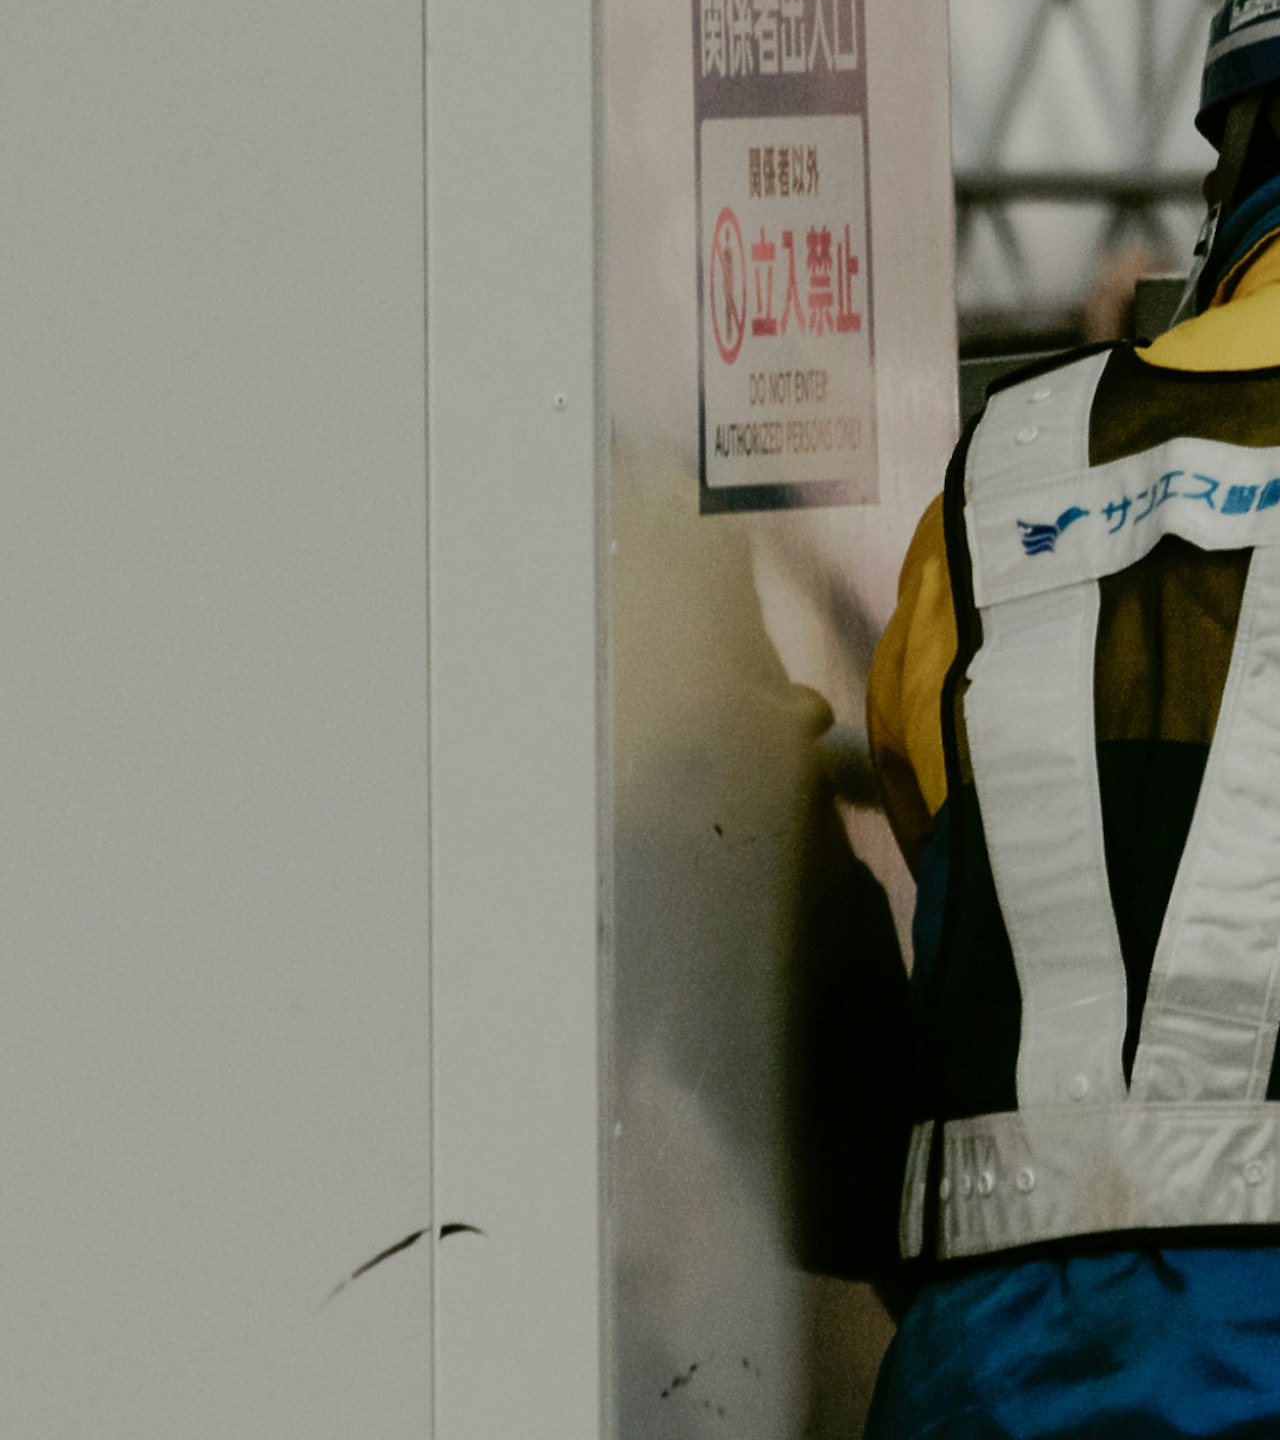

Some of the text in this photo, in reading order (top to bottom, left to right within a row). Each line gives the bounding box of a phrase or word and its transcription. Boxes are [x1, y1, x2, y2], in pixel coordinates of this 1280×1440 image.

[748, 144, 820, 198] 関係者以外
[751, 224, 862, 337] 立入禁止
[749, 369, 829, 406] DO NOT ENTER
[714, 421, 784, 459] AUTHORIZED
